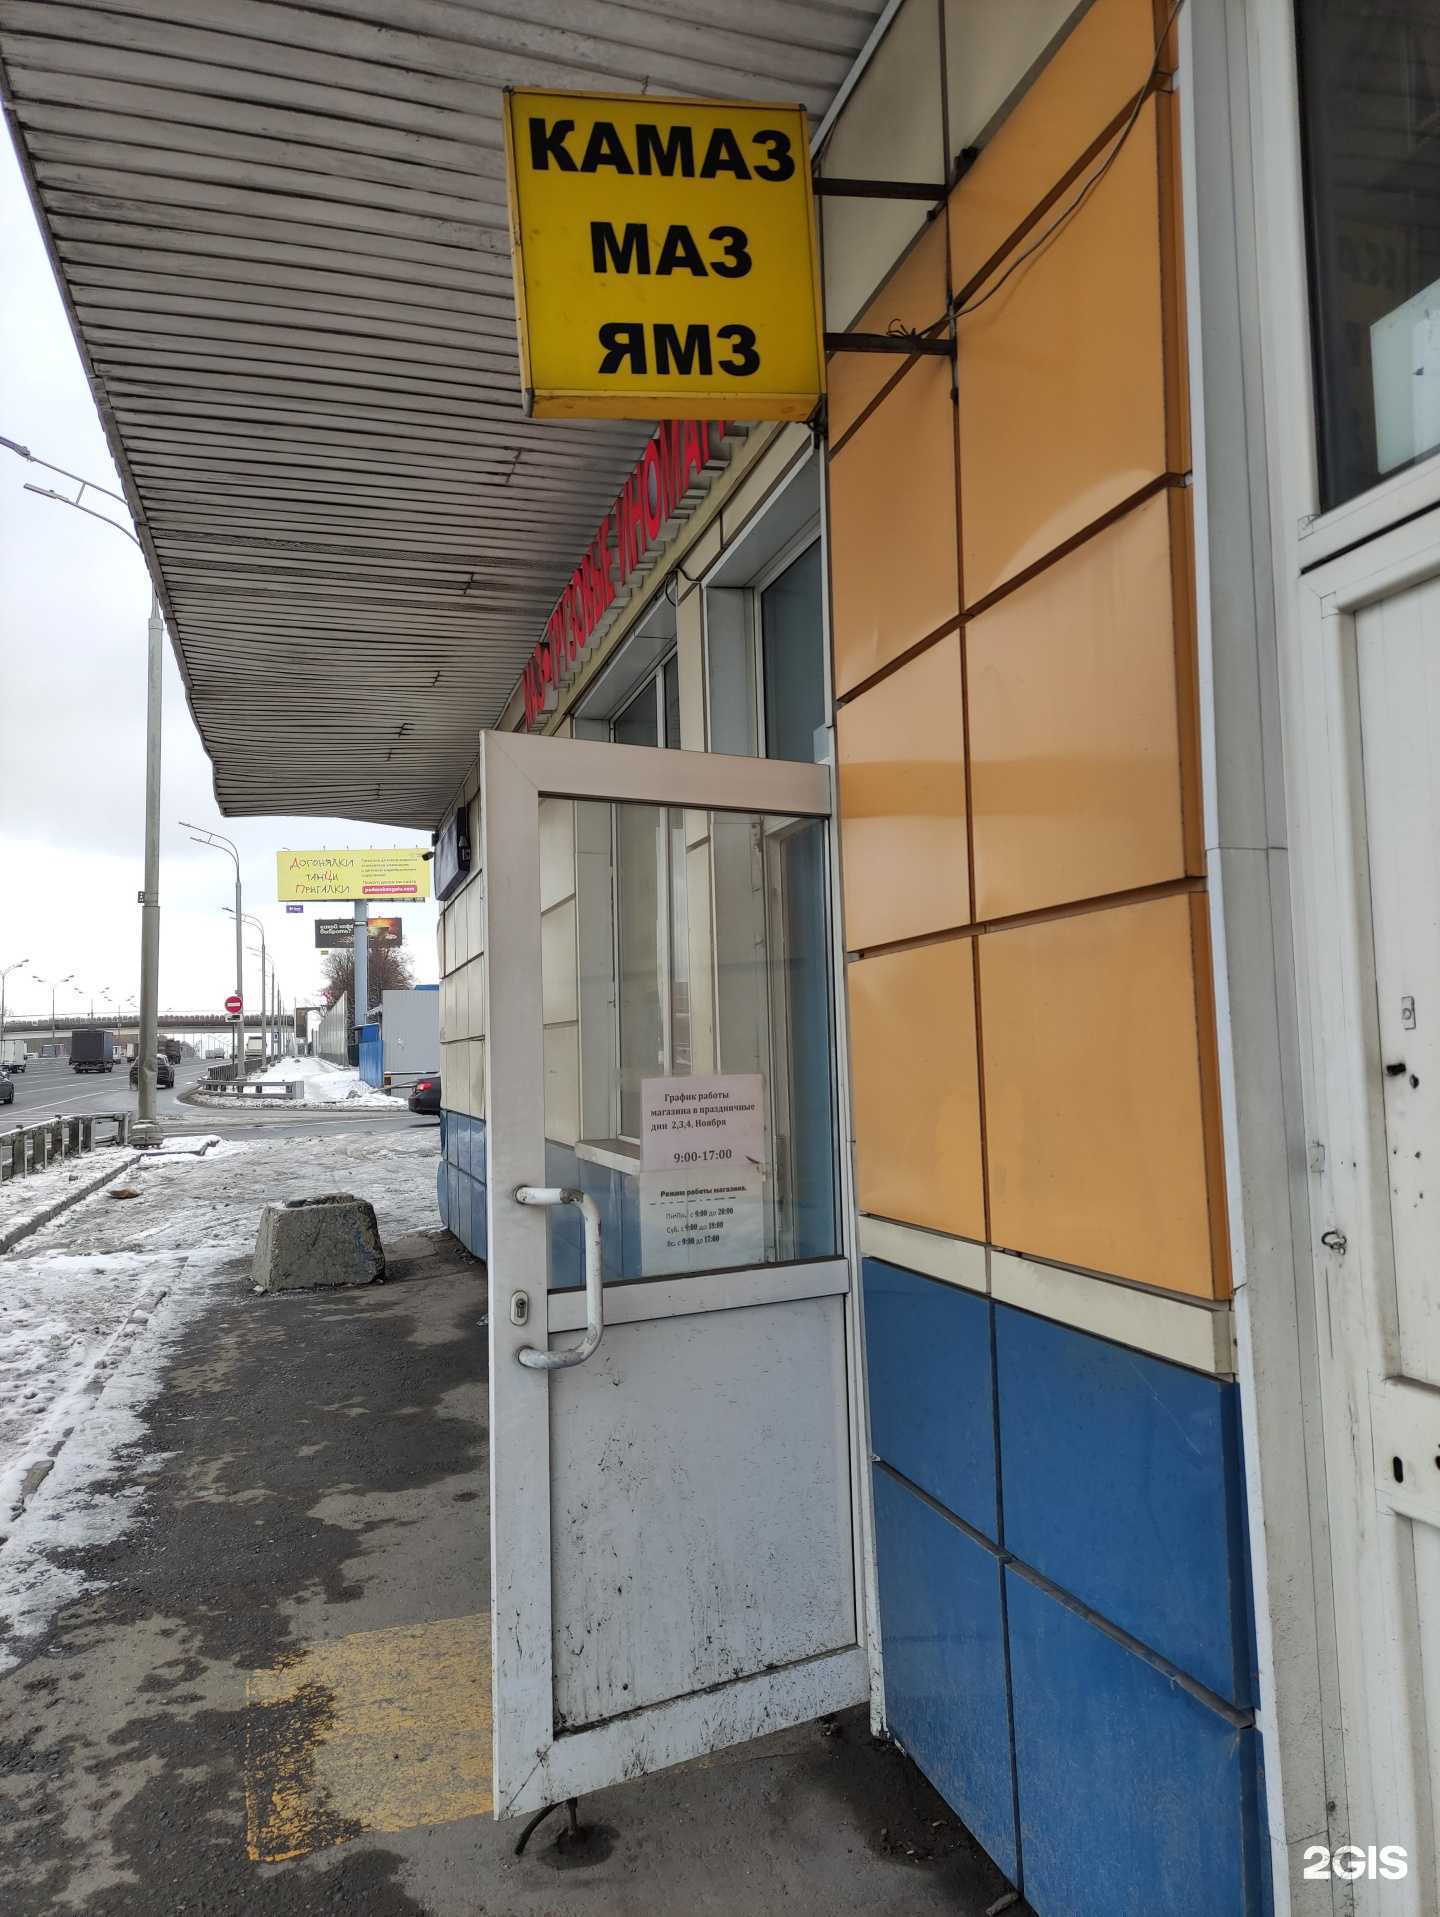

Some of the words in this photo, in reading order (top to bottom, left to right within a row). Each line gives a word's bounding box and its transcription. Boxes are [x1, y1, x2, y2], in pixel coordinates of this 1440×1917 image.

[528, 118, 795, 182] КАМАЗ
[590, 221, 753, 278] МАЗ
[598, 322, 761, 376] ЯМЗ
[664, 1093, 696, 1103] График
[698, 1091, 729, 1101] работы
[650, 1108, 691, 1116] магазина
[699, 1104, 755, 1115] праздничные
[651, 1123, 668, 1132] дни
[695, 1118, 727, 1128] Ноября
[674, 1149, 732, 1163] 9:00-17:00
